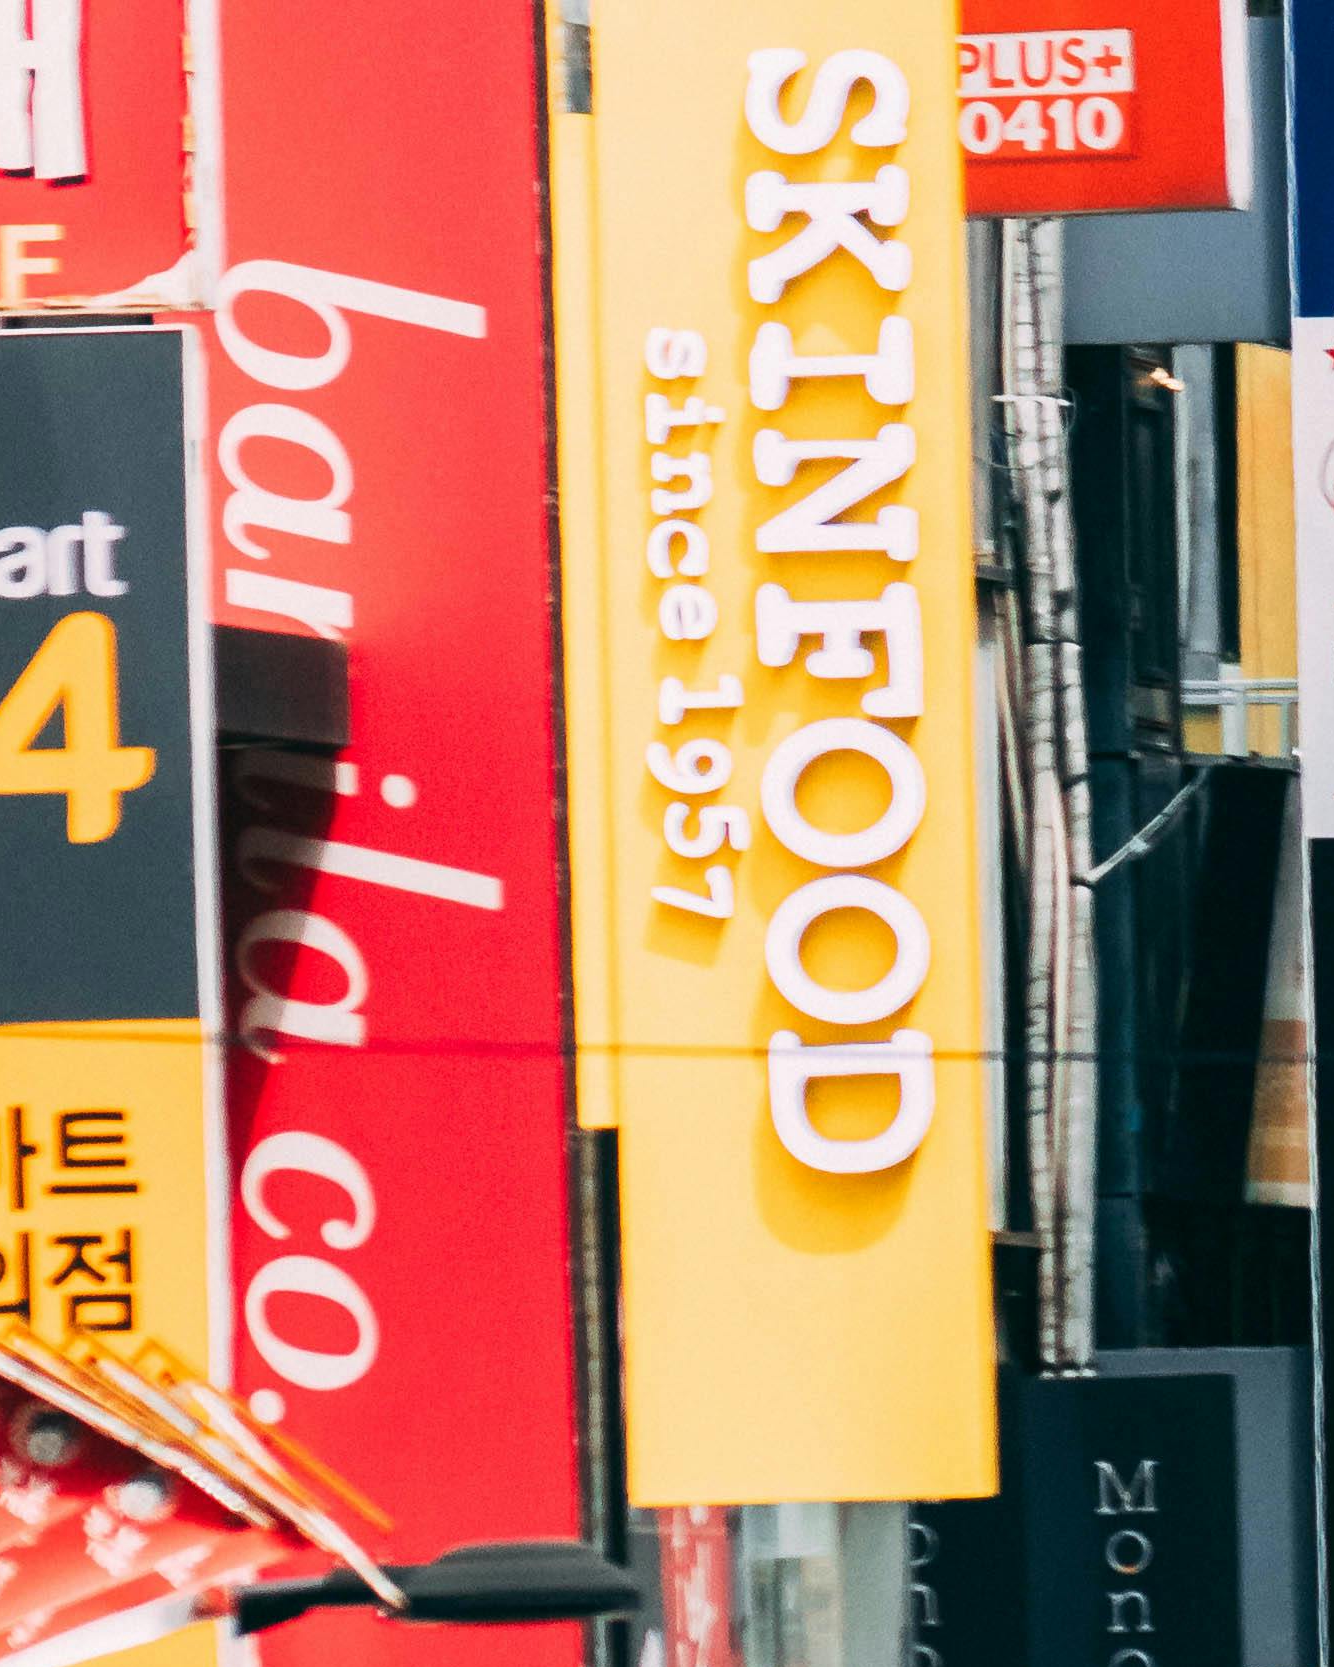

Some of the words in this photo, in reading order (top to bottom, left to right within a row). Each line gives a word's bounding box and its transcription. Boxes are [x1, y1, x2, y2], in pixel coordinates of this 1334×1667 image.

[959, 97, 1124, 152] 0410
[645, 327, 727, 642] since
[745, 47, 934, 1174] SKINFOOD
[645, 673, 753, 920] 1957
[240, 1130, 379, 1425] co.
